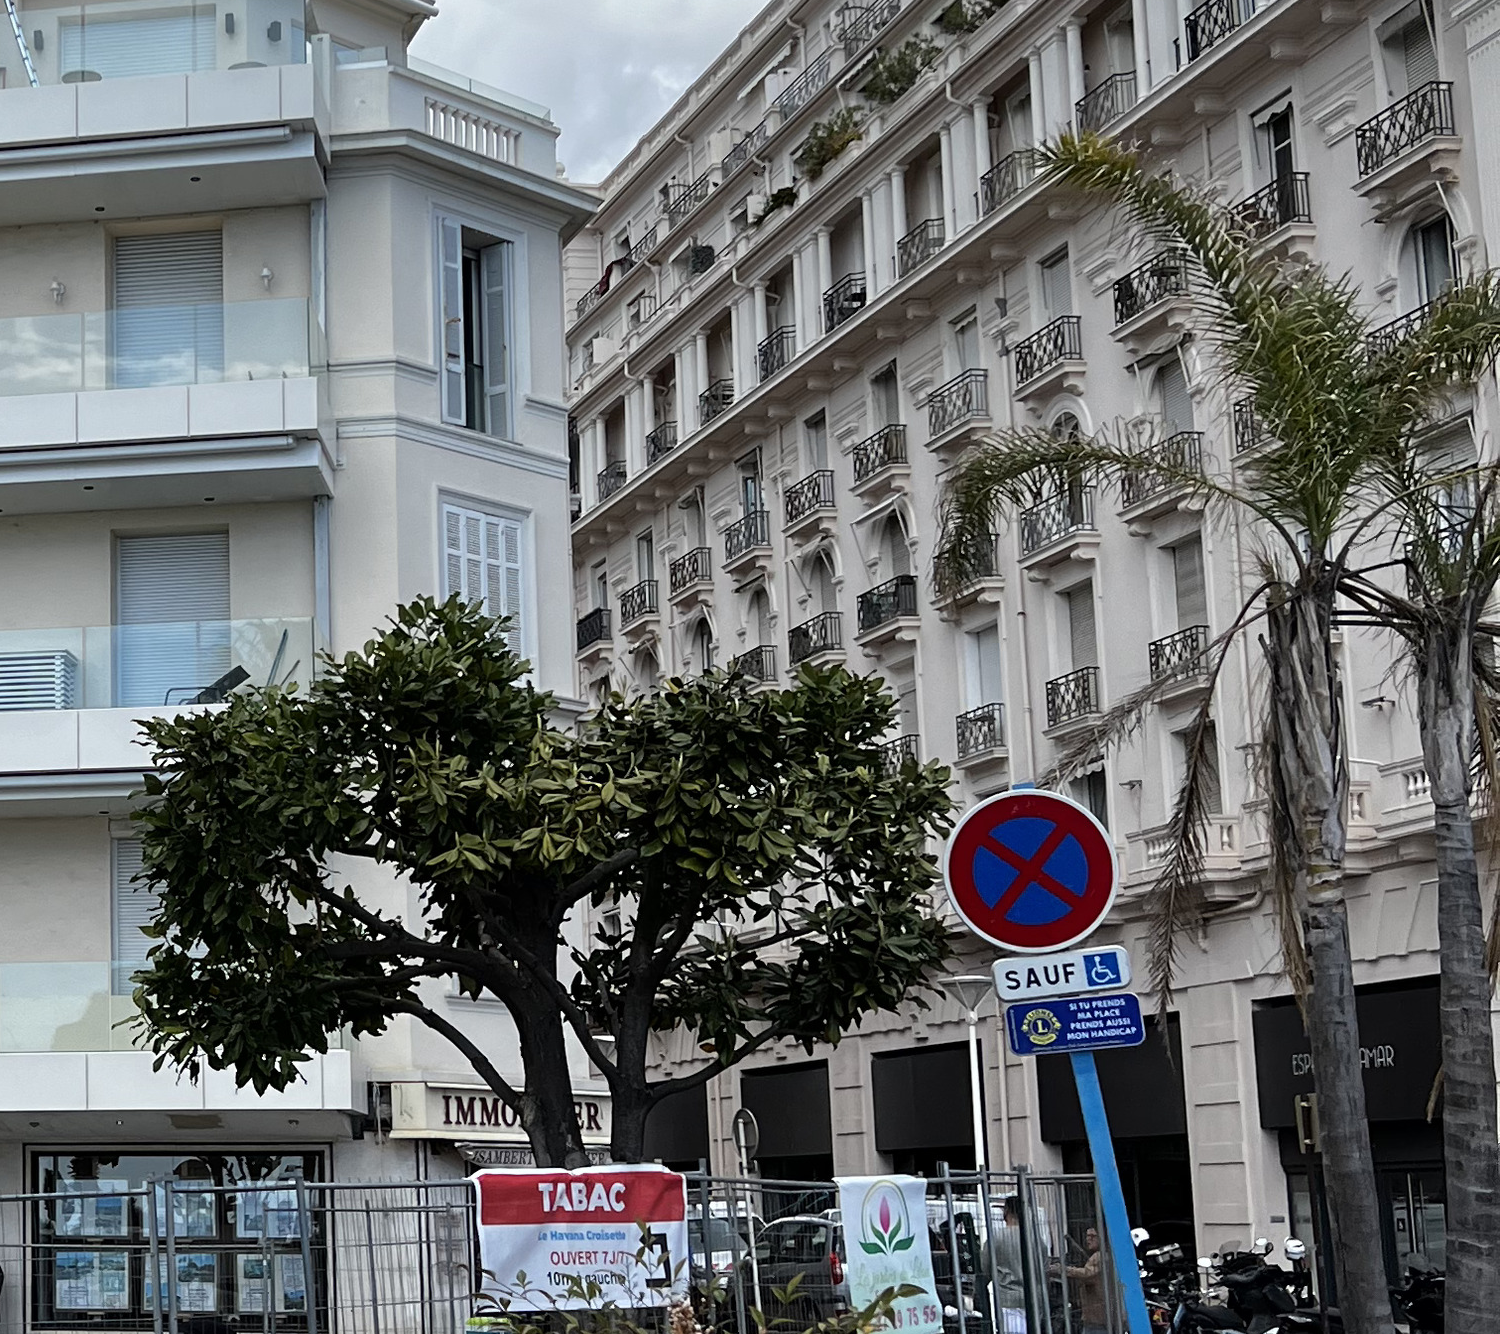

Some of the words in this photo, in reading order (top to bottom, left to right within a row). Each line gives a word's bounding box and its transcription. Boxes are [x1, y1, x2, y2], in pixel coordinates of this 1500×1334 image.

[1005, 963, 1076, 990] SAUF
[1069, 1002, 1078, 1011] SI
[1079, 1001, 1090, 1010] TU
[1092, 998, 1126, 1009] PRENDS
[1077, 1011, 1092, 1020] MA
[1094, 1008, 1120, 1019] PLACE
[1036, 1019, 1048, 1034] L
[1070, 1019, 1104, 1030] PRENDS
[1106, 1017, 1131, 1027] AUSSI
[1067, 1031, 1090, 1041] MON
[1091, 1027, 1137, 1038] HANDICAP
[443, 1095, 602, 1131] IMMOER
[538, 1182, 626, 1213] TABAC
[550, 1230, 585, 1241] Havana
[586, 1229, 626, 1241] Croisette
[550, 1251, 599, 1266] OUVERT
[585, 1270, 626, 1288] gauch
